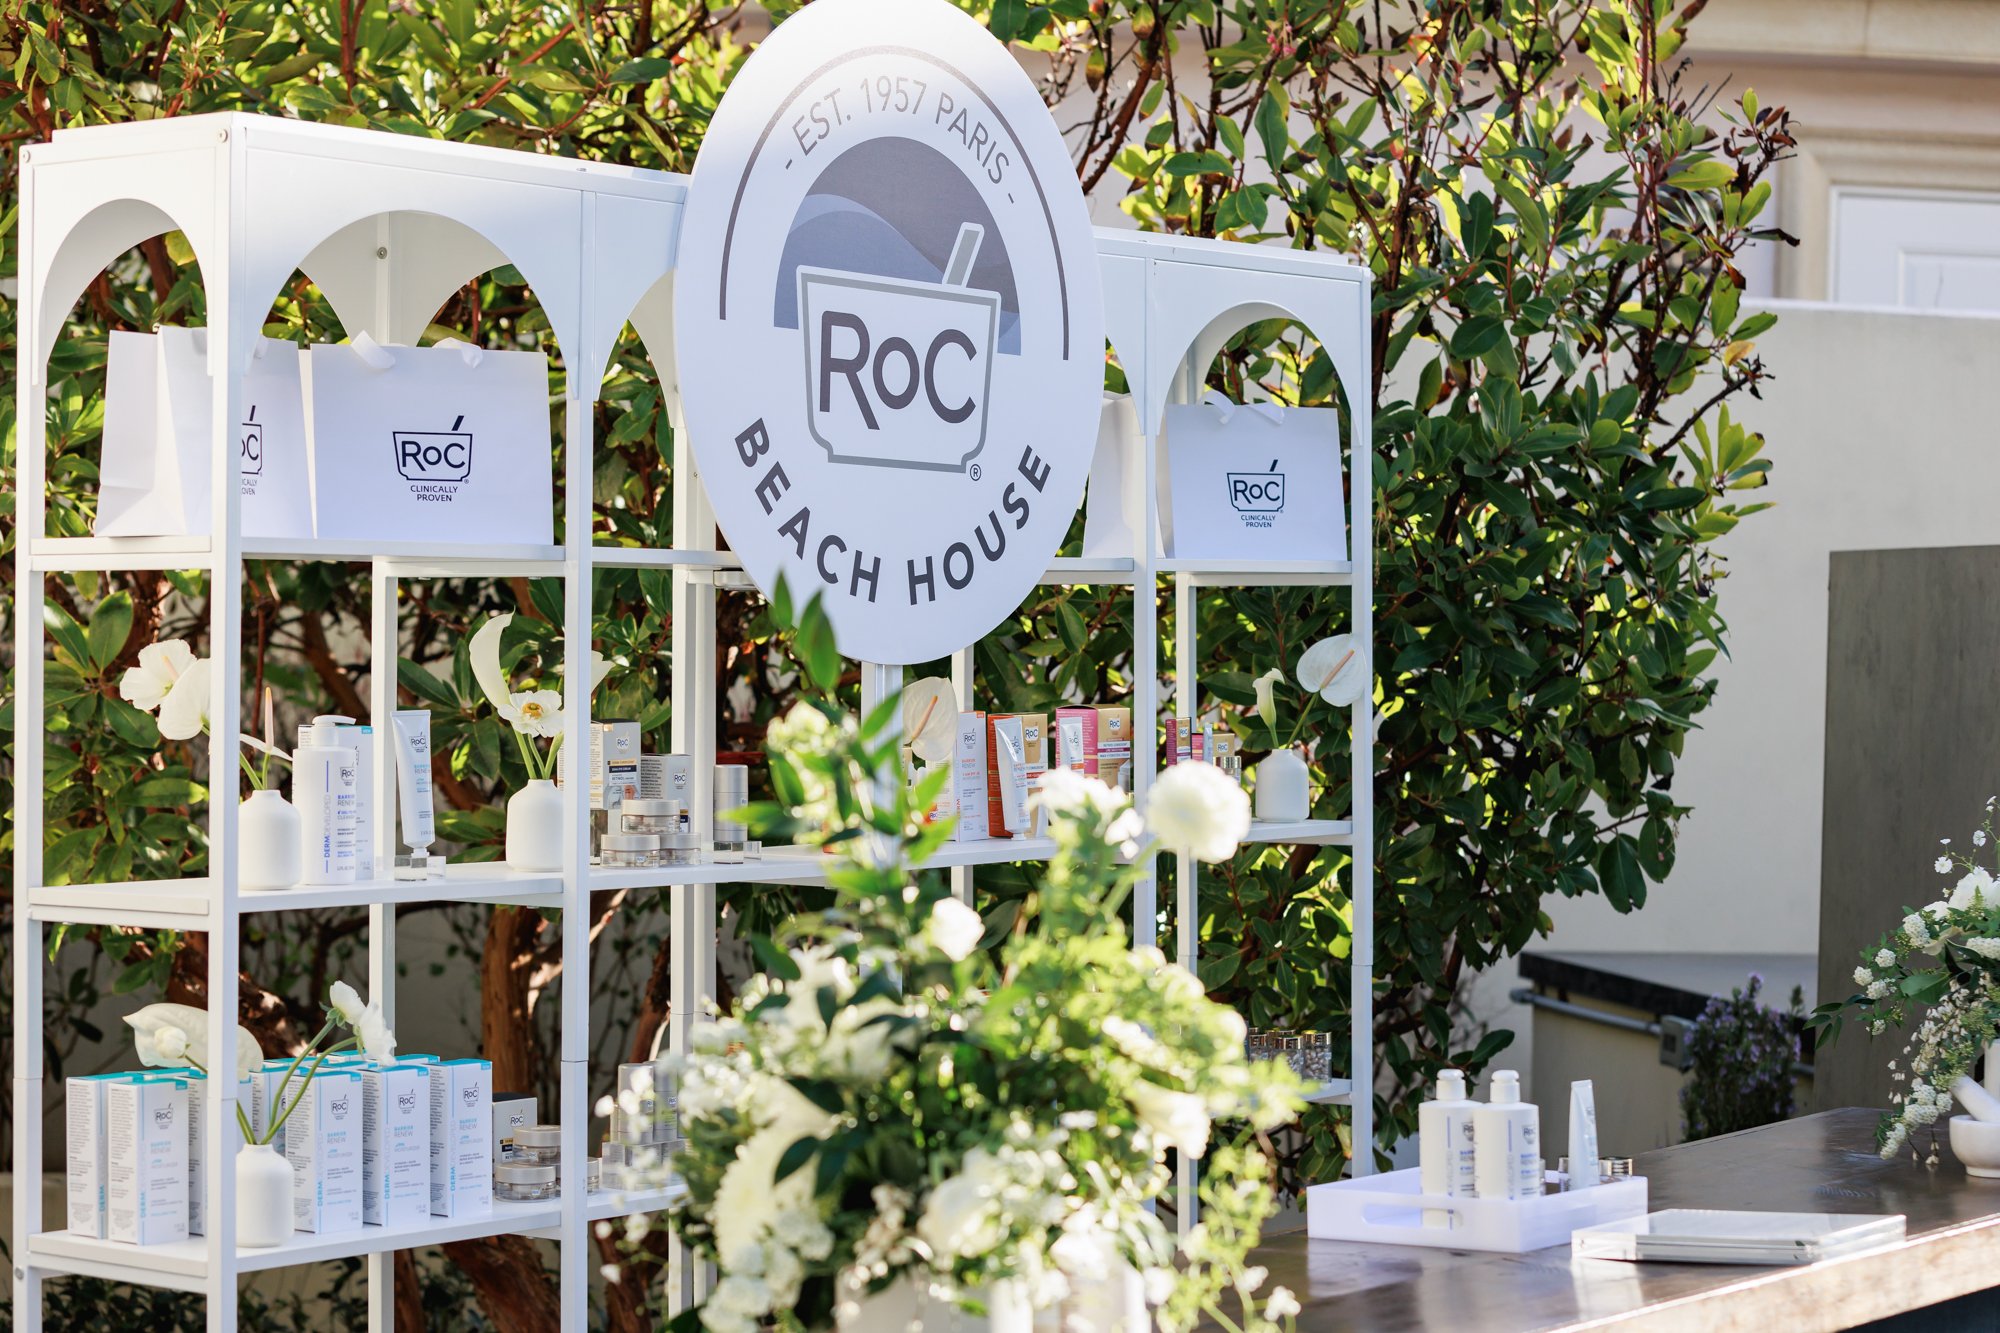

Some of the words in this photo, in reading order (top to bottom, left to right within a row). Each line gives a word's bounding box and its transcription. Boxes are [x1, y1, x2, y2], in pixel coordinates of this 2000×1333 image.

[793, 88, 852, 157] EST.
[859, 75, 928, 116] 1957
[933, 92, 1012, 185] PARIS
[818, 309, 978, 431] RoC
[401, 440, 466, 472] RoC
[410, 484, 459, 494] CLINICALLY
[416, 493, 453, 502] PROVEN
[1233, 479, 1280, 504] RoC
[734, 416, 882, 604] BEACH
[906, 444, 1052, 606] HOUSE
